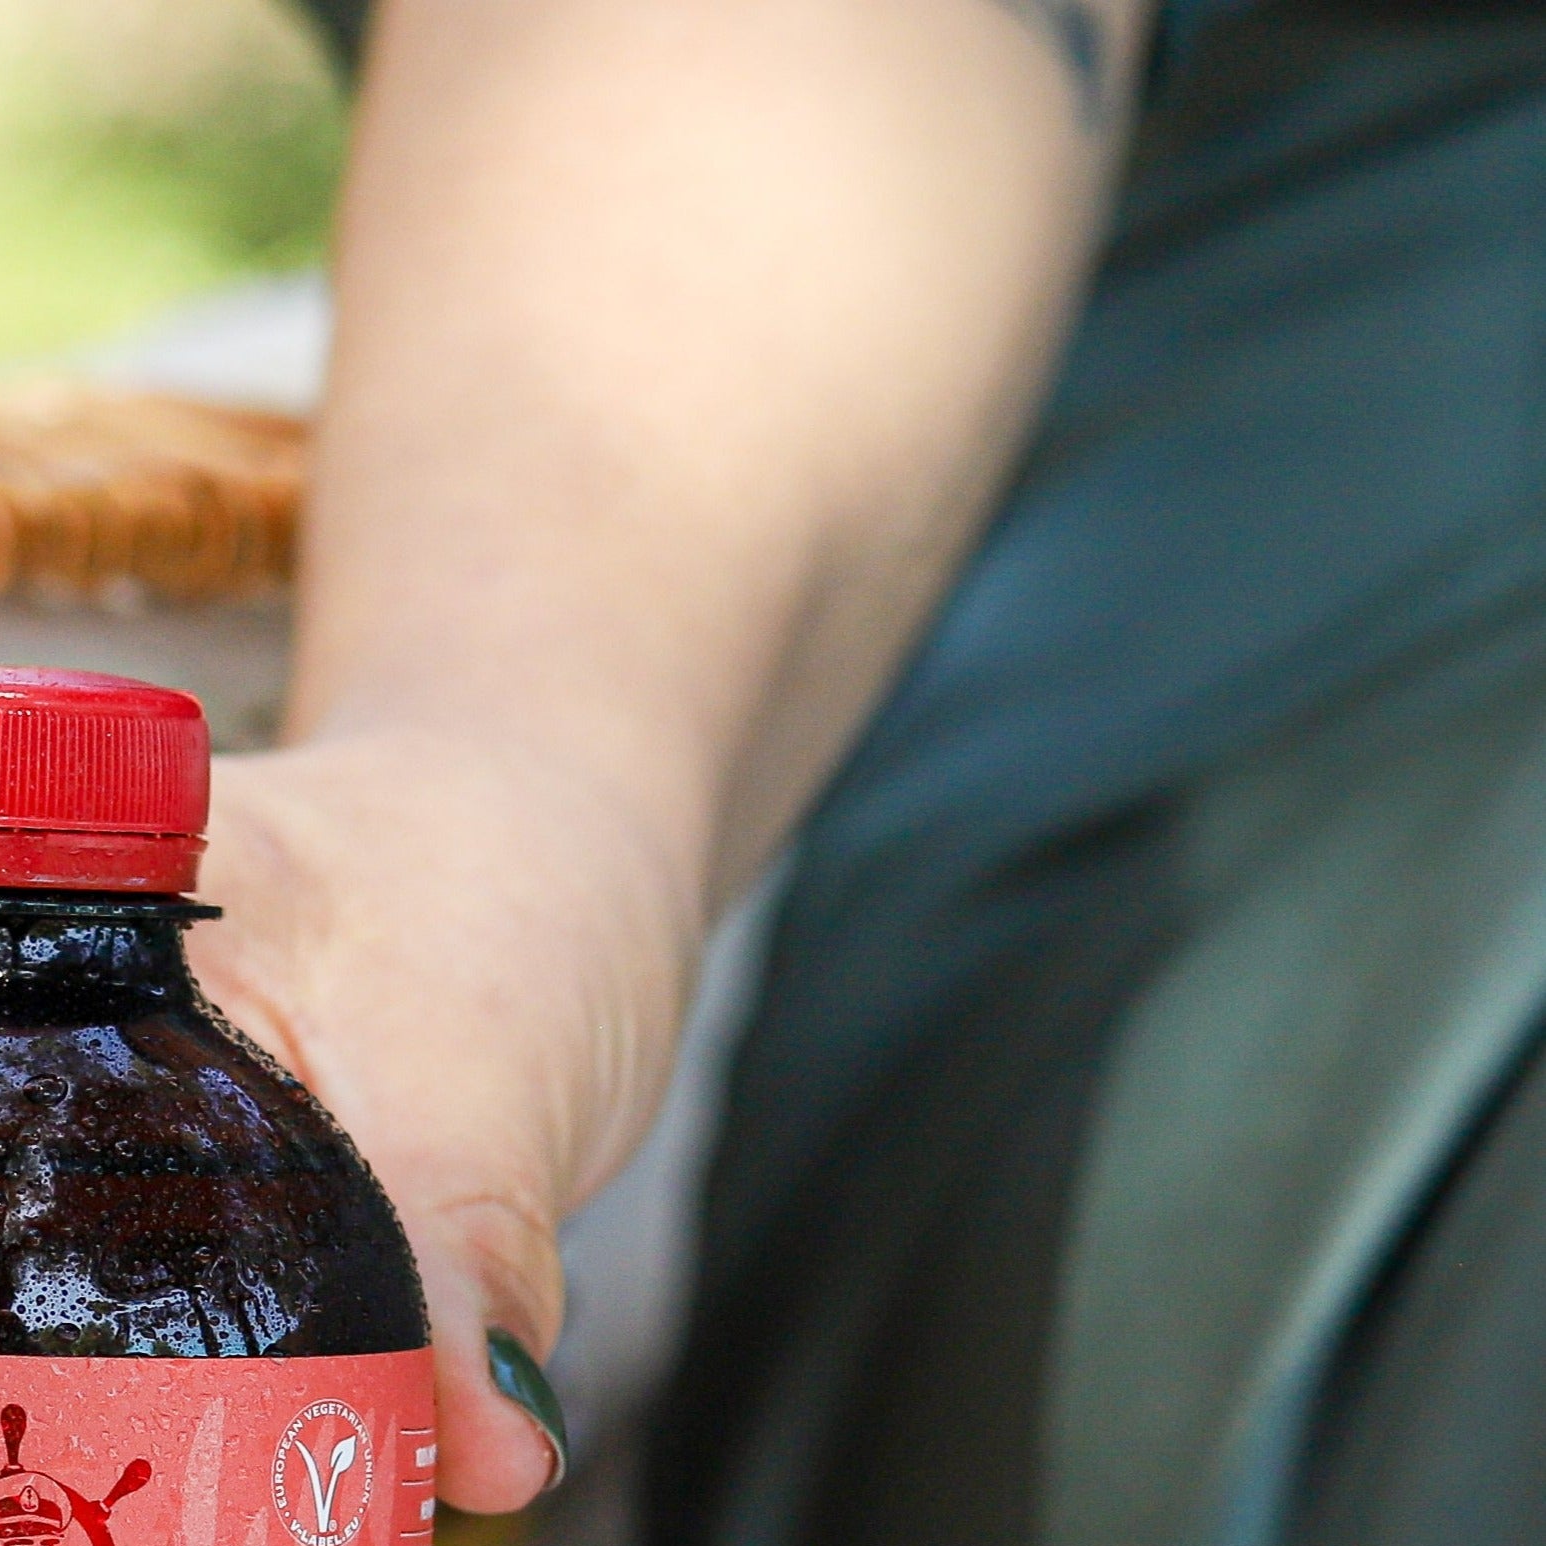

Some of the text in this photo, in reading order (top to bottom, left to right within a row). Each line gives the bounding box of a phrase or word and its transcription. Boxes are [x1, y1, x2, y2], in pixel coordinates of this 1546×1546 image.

[274, 1419, 303, 1509] EUROPEAN
[304, 1403, 368, 1444] VEGETARIAN
[362, 1449, 373, 1503] UNION
[290, 1516, 359, 1546] V-LABEL.EU
